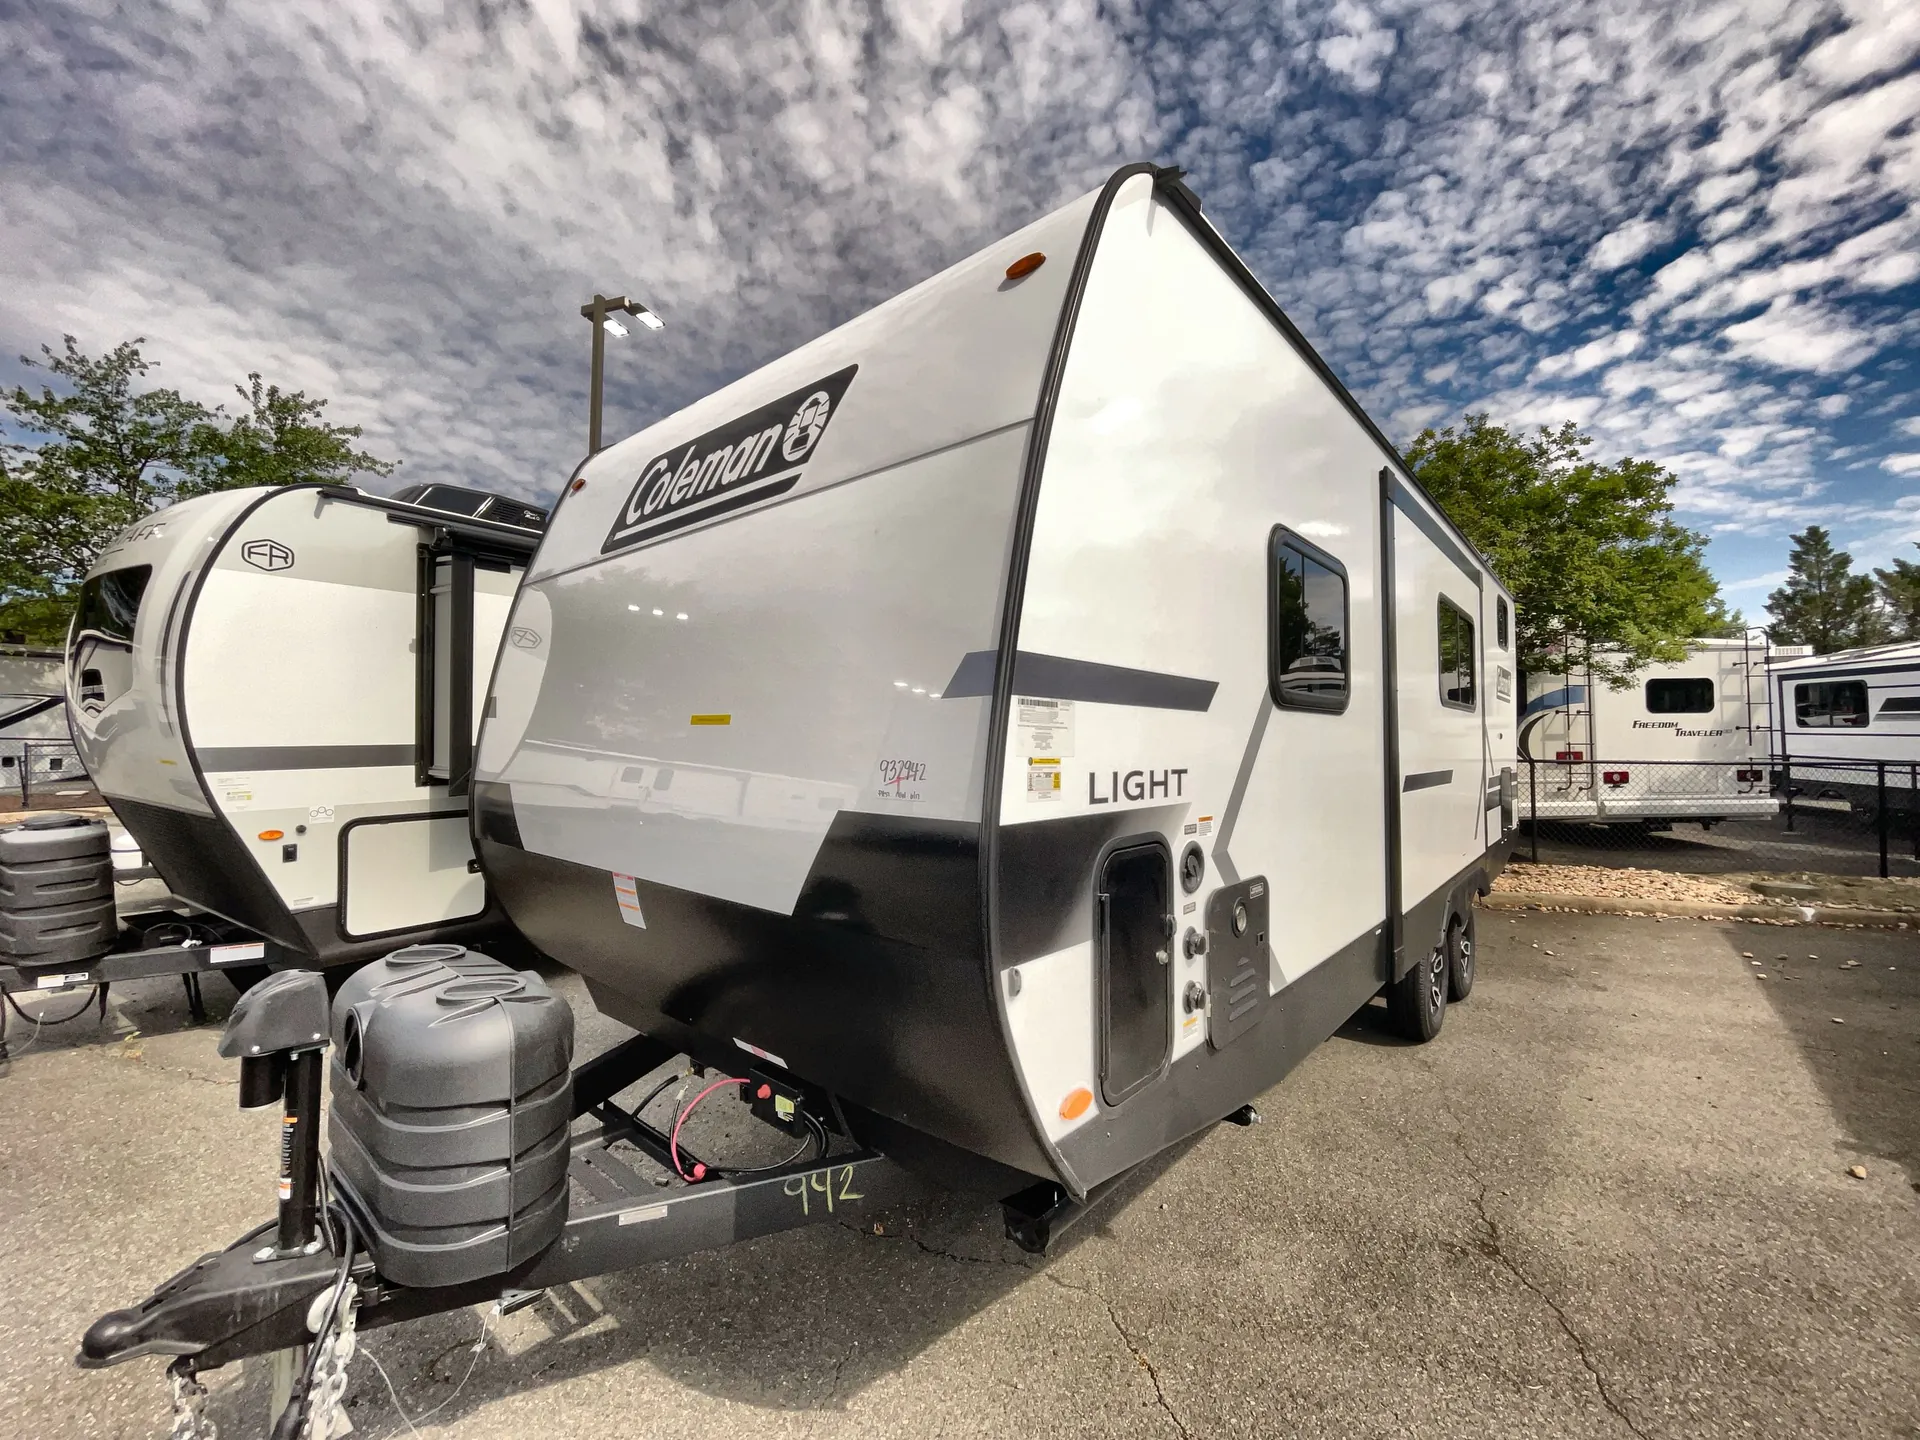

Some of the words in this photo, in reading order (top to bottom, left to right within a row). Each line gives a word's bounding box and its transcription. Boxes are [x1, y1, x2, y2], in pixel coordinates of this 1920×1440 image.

[626, 423, 783, 525] Coleman
[247, 543, 289, 567] FR
[1089, 768, 1188, 805] LIGHT
[783, 1163, 865, 1216] 942
